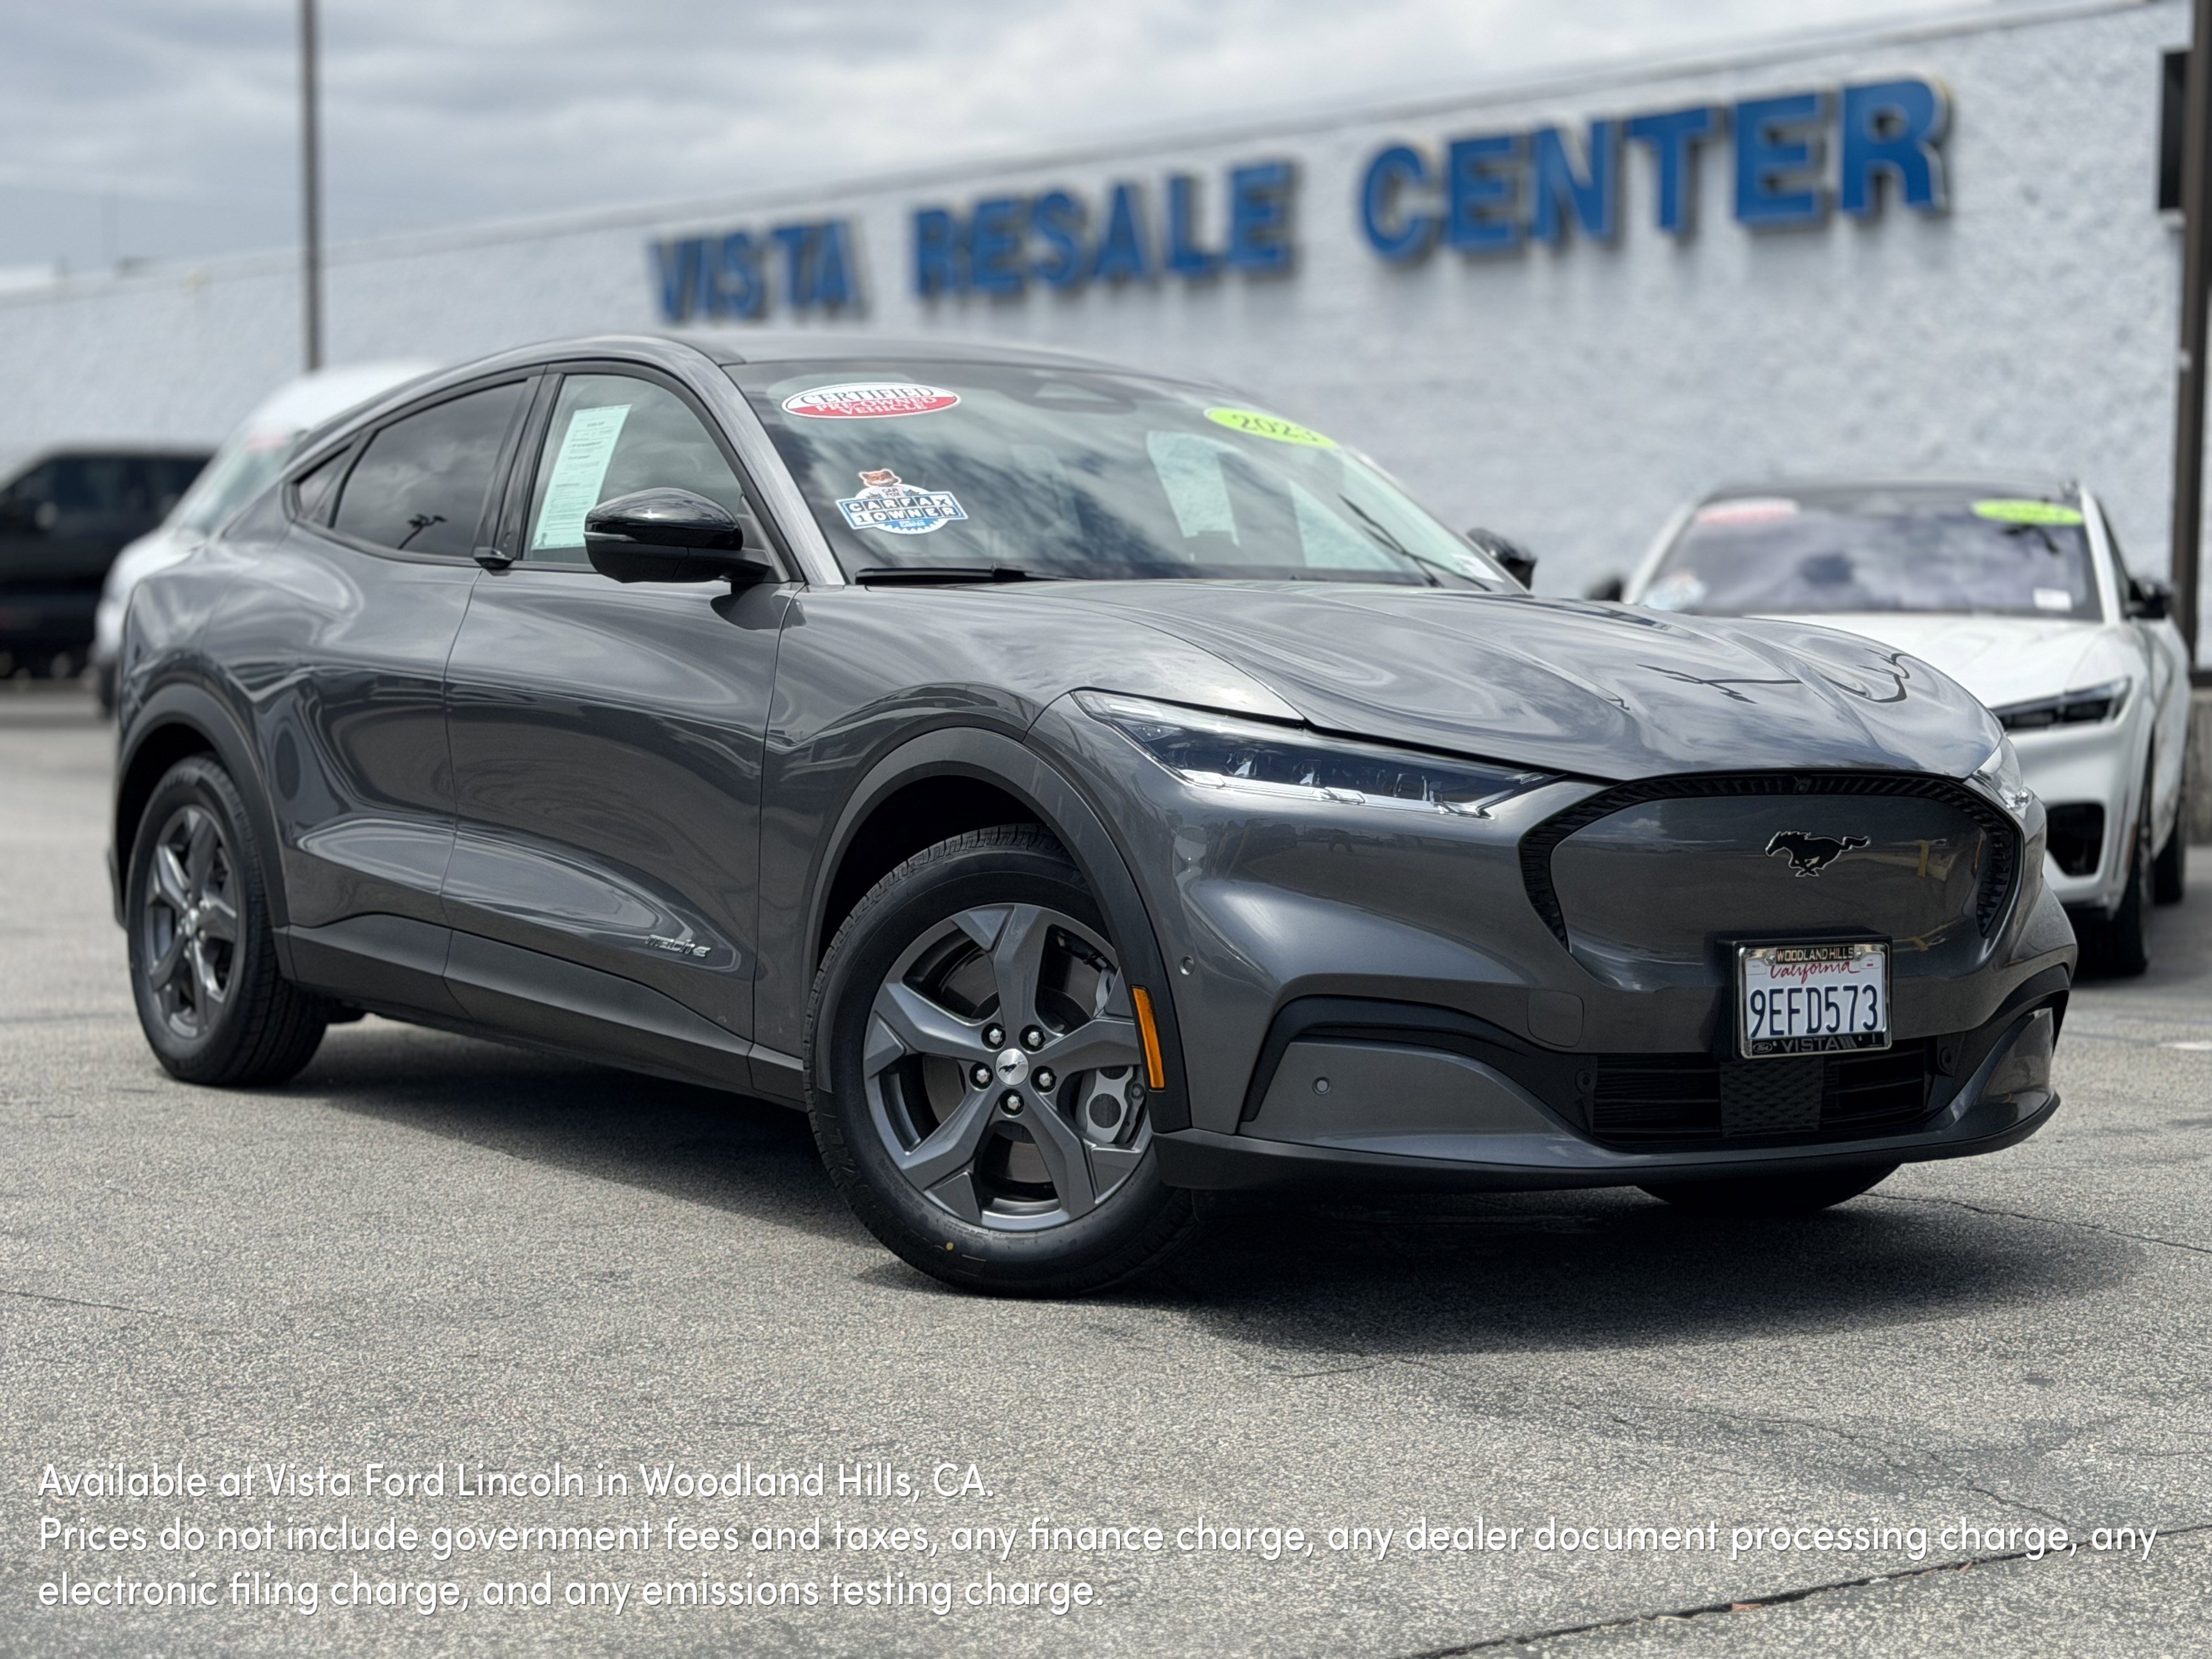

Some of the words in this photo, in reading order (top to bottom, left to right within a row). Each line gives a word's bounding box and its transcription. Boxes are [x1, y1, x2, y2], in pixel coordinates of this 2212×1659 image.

[649, 219, 862, 321] VISTA
[914, 161, 1296, 296] RESALE
[1359, 78, 1951, 263] CENTER
[800, 388, 934, 404] CERTIFIED
[816, 397, 937, 412] PRE-OWNED
[842, 403, 928, 415] VEHICLE
[848, 496, 950, 512] CARFAX
[856, 513, 868, 522] 1
[872, 506, 957, 521] OWNER
[1776, 949, 1828, 962] WOODLAND
[1829, 947, 1854, 960] HILLS
[1770, 961, 1860, 984] California
[1750, 984, 1878, 1037] 9EFD573
[1780, 1037, 1843, 1053] VISTA
